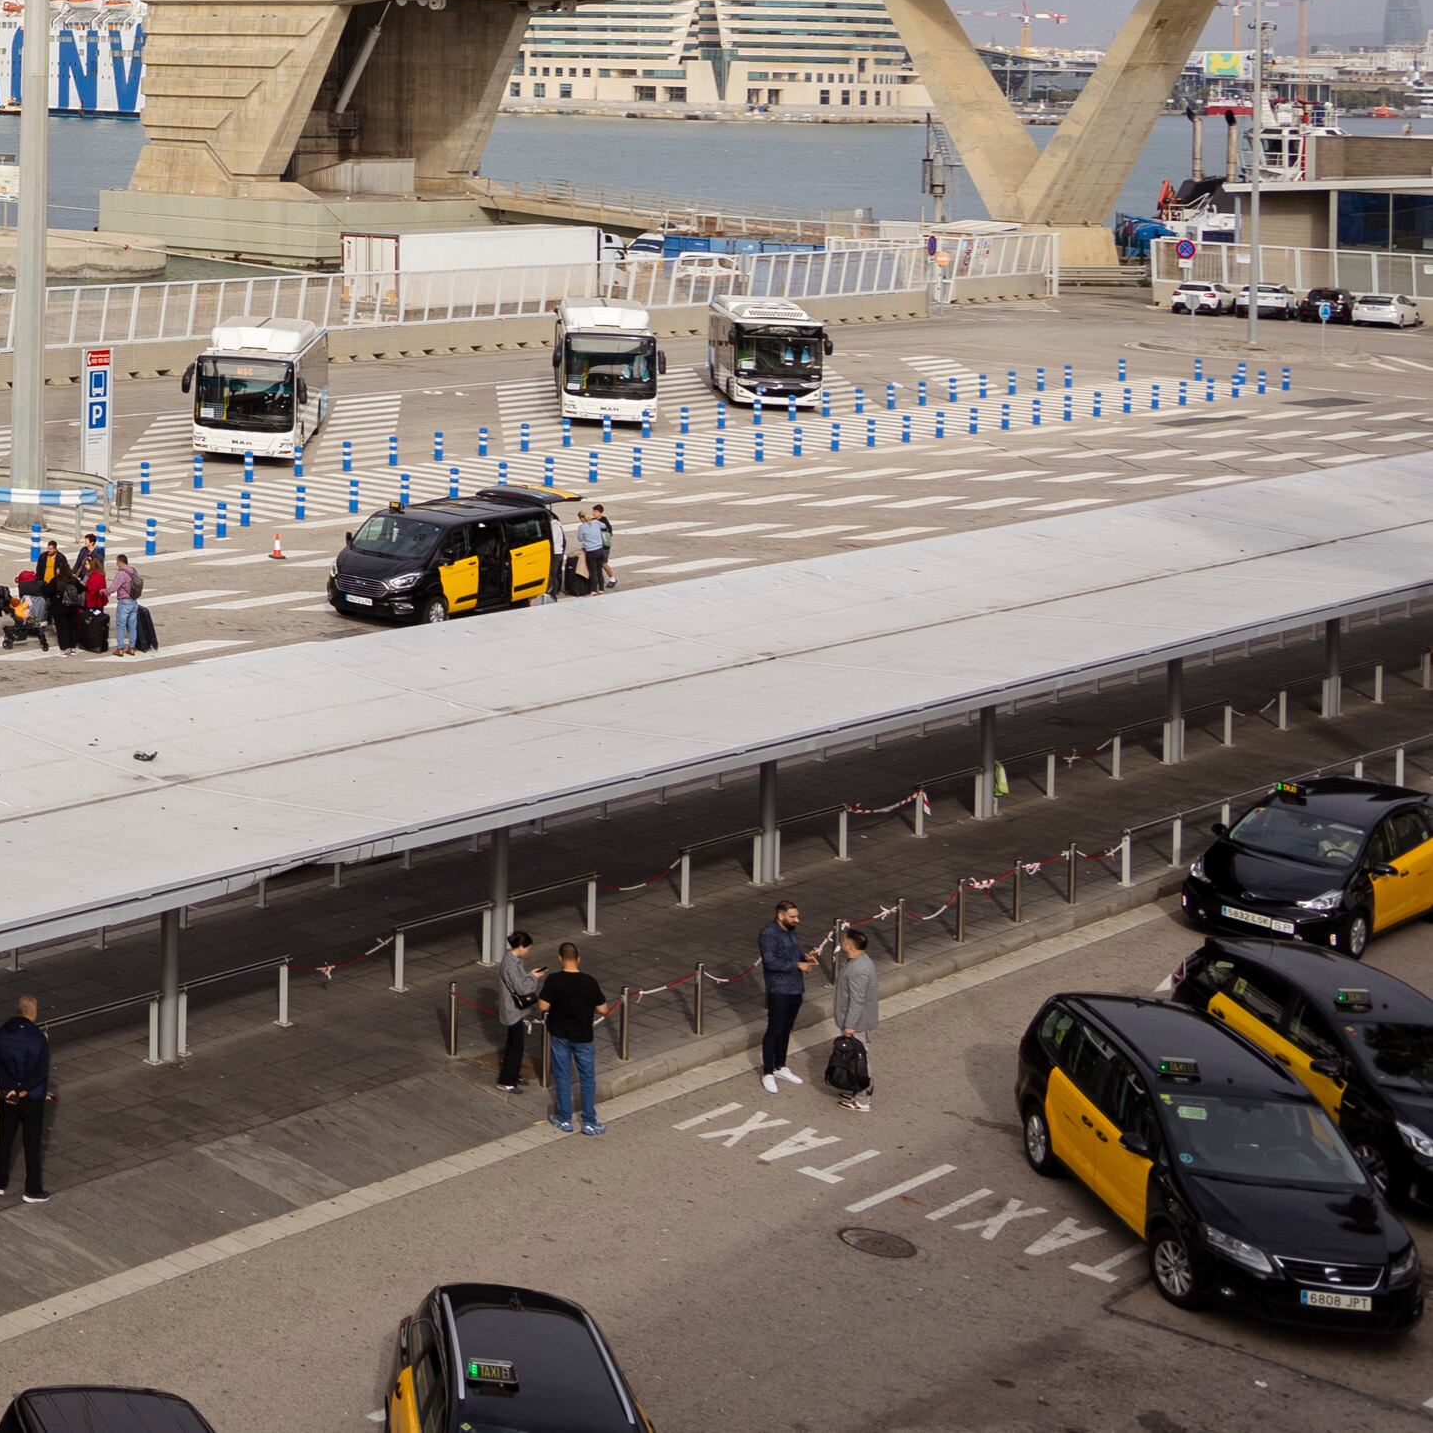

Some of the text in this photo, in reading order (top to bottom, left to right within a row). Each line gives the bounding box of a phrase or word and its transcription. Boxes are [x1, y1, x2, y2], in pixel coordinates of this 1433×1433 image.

[236, 367, 254, 377] MSC
[92, 404, 104, 426] P
[1282, 783, 1298, 794] TAXI
[672, 1102, 882, 1184] TAXI
[925, 1188, 1146, 1283] TAXI
[1309, 1293, 1368, 1309] 6808 JPT
[481, 1365, 500, 1378] TAXI
